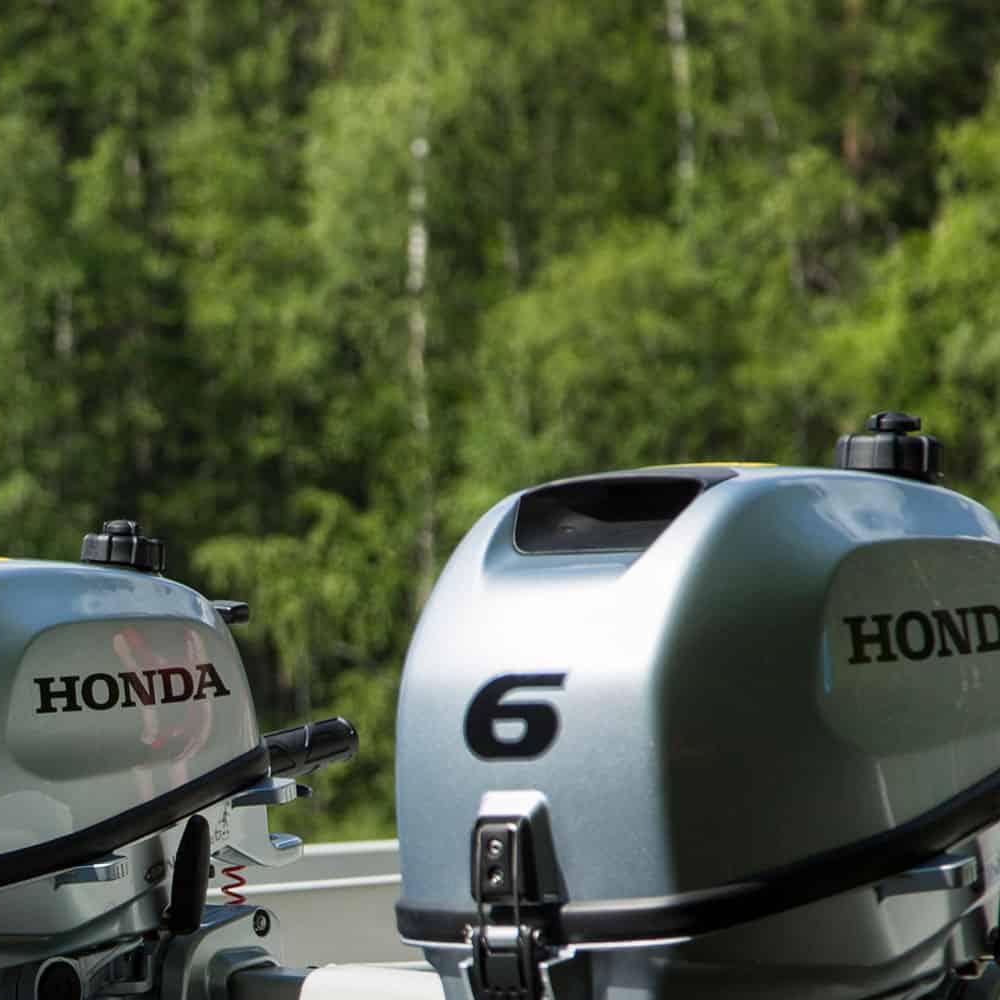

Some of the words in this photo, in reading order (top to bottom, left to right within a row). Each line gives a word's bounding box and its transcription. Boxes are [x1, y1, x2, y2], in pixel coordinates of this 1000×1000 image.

[842, 605, 1000, 664] HOND
[33, 663, 230, 713] HONDA
[463, 672, 566, 762] 6
